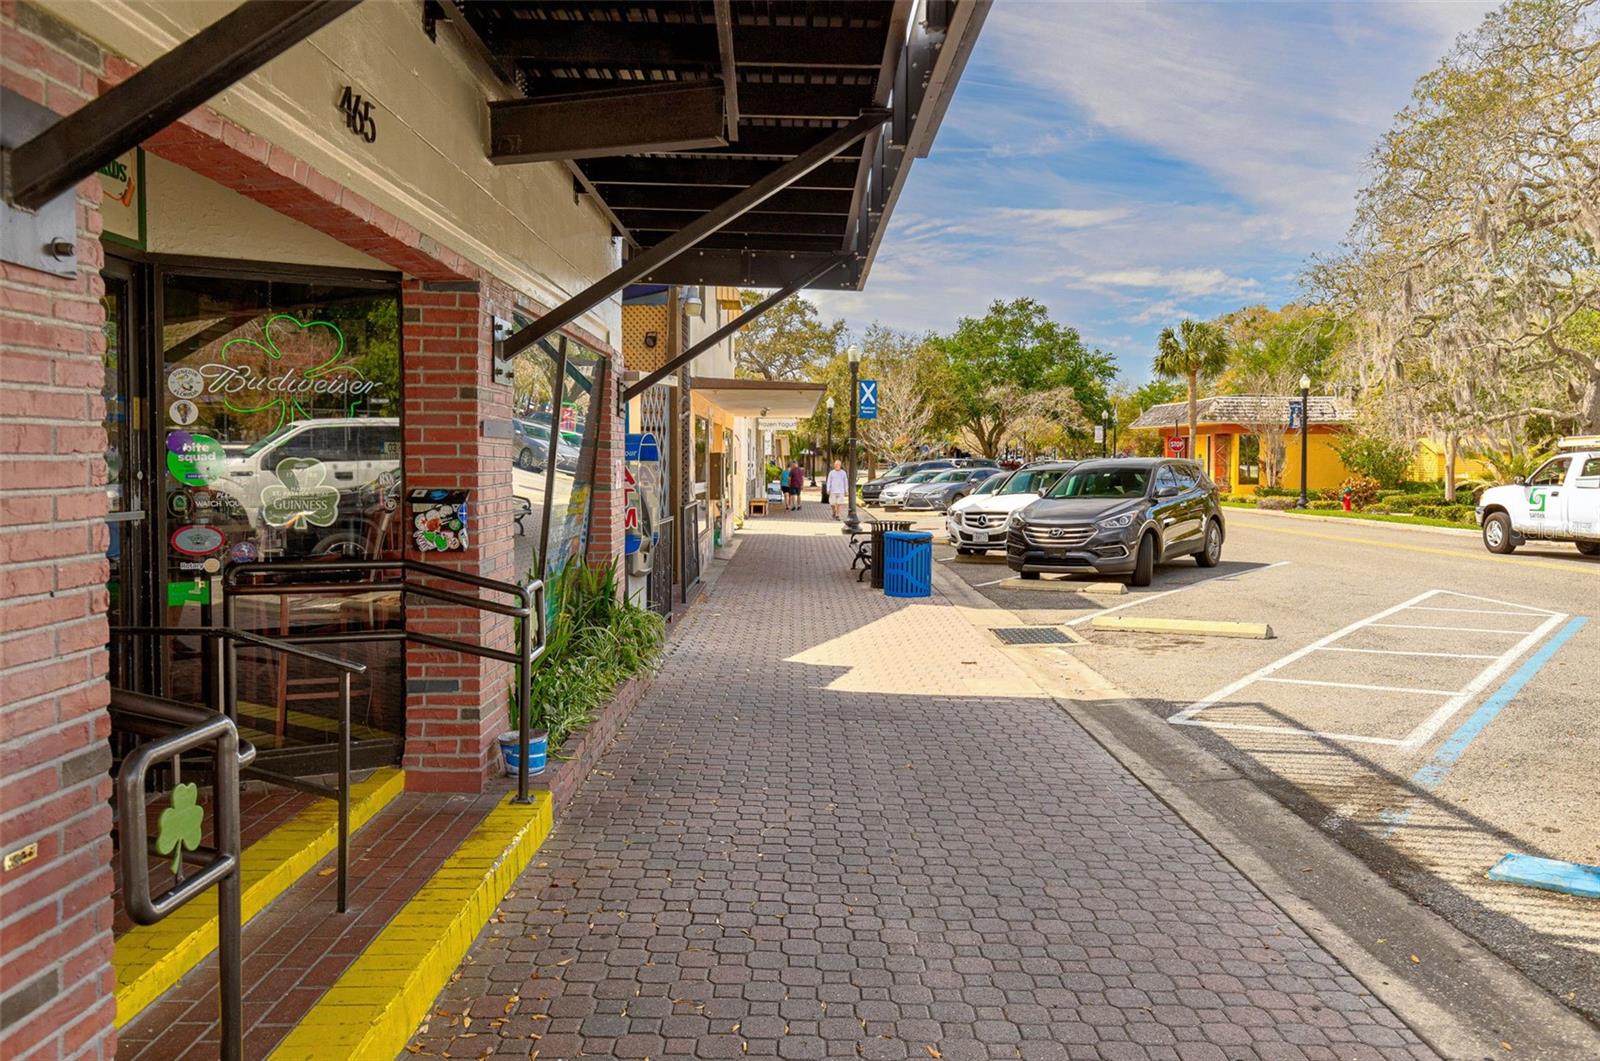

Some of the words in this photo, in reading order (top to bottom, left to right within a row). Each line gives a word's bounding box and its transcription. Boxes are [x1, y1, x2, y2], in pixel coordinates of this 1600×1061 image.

[340, 86, 376, 143] 465
[200, 363, 383, 395] Budweiser
[182, 442, 209, 452] bite
[178, 452, 216, 463] squad
[195, 500, 222, 508] WATCH
[273, 498, 328, 510] GUINNESS
[180, 561, 205, 570] Rotary
